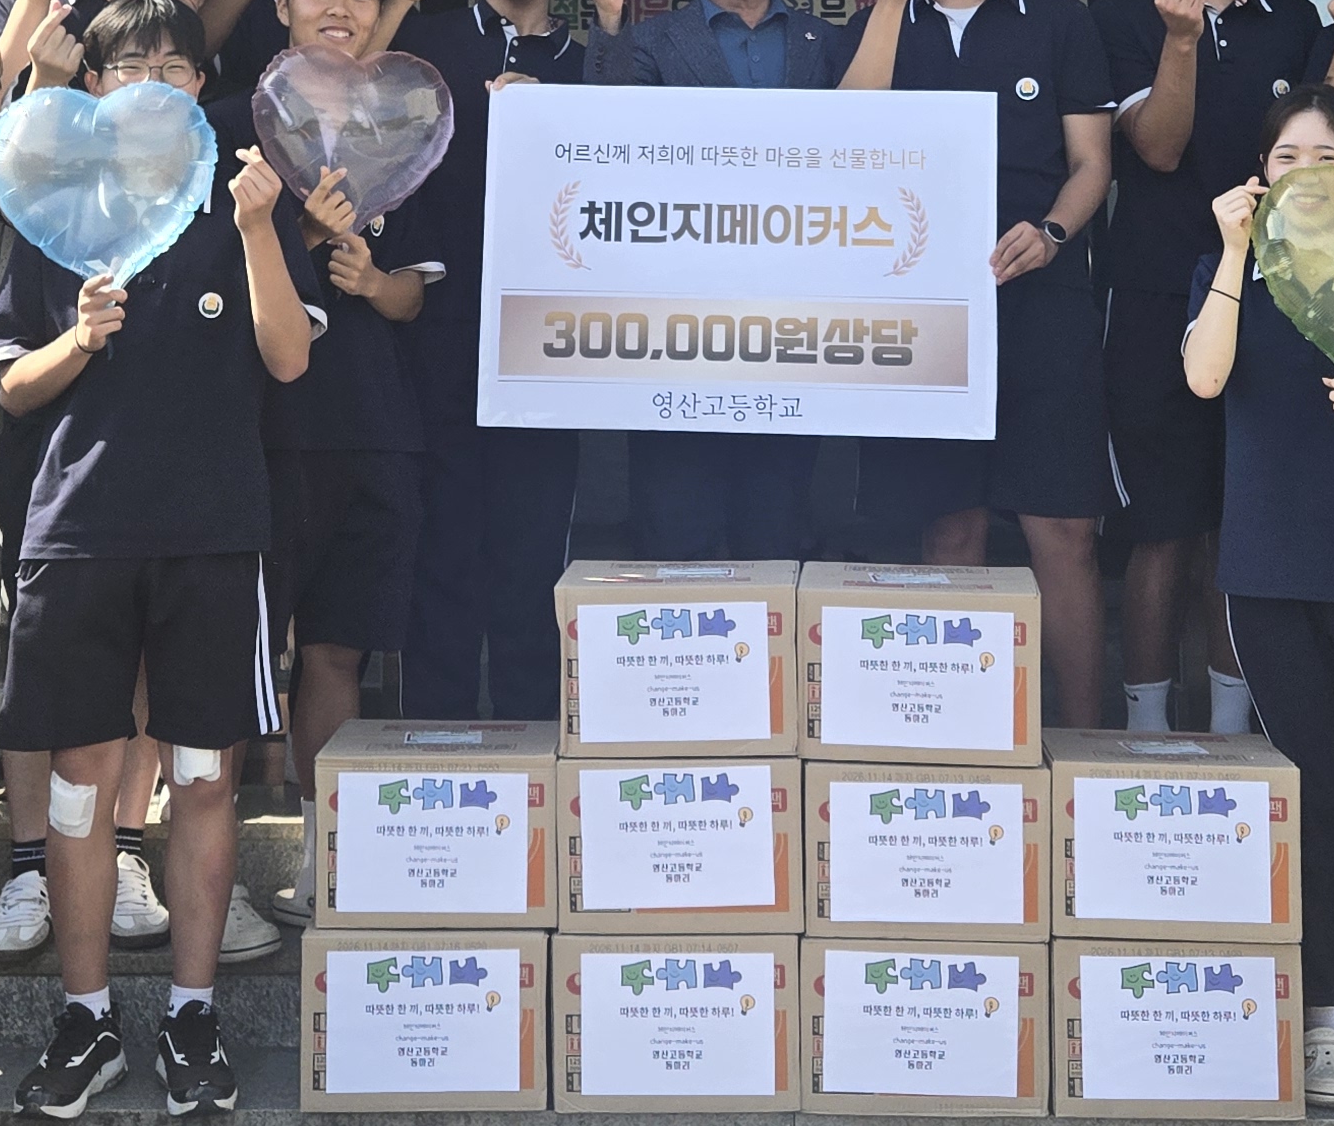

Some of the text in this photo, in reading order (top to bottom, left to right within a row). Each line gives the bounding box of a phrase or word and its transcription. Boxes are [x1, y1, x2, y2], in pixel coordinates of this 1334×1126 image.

[554, 142, 926, 171] 어르신께 저희에 따뜻한 마음을 선물합니다
[578, 200, 895, 248] 체인지메이커스
[651, 391, 804, 423] 영산고등학교
[617, 656, 645, 667] 따뜻한
[648, 656, 657, 666] 한
[675, 656, 703, 666] 따뜻한
[707, 655, 729, 665] 하루!
[860, 660, 888, 671] 따뜻한
[892, 661, 900, 671] 한
[919, 662, 948, 673] 따뜻한
[951, 663, 973, 674] 하루!
[650, 697, 699, 706] 영산고등학교
[892, 703, 941, 714] 영산고등학교
[377, 826, 405, 836] 따뜻한
[409, 826, 417, 836] 한
[435, 826, 463, 837] 따뜻한
[467, 826, 489, 837] 하루!
[619, 821, 647, 832] 따뜻한
[651, 821, 659, 832] 한
[678, 820, 707, 831] 따뜻한
[710, 820, 732, 830] 하루!
[869, 835, 897, 846] 따뜻한
[901, 836, 909, 846] 한
[928, 836, 957, 847] 따뜻한
[960, 837, 982, 847] 하루!
[1114, 832, 1143, 843] 따뜻한
[1146, 832, 1155, 843] 한
[1174, 833, 1203, 844] 따뜻한
[1206, 834, 1229, 845] 하루!
[408, 868, 457, 877] 영산고등학교
[653, 864, 702, 872] 영산고등학교
[901, 878, 950, 888] 영산고등학교
[1147, 876, 1197, 886] 영산고등학교
[366, 1004, 394, 1015] 따뜻한
[398, 1004, 406, 1015] 한
[425, 1003, 454, 1015] 따뜻한
[458, 1003, 479, 1014] 하루!
[620, 1007, 648, 1018] 따뜻한
[652, 1007, 661, 1018] 한
[679, 1007, 708, 1018] 따뜻한
[712, 1006, 734, 1018] 하루!
[863, 1005, 892, 1016] 따뜻한
[896, 1006, 904, 1017] 한
[923, 1007, 952, 1019] 따뜻한
[955, 1008, 978, 1019] 하루!
[1121, 1010, 1150, 1021] 따뜻한
[1153, 1010, 1162, 1021] 한
[1181, 1011, 1210, 1022] 따뜻한
[1213, 1012, 1236, 1022] 하루!
[398, 1047, 447, 1056] 영산고등학교
[653, 1050, 702, 1059] 영산고등학교
[895, 1050, 945, 1060] 영산고등학교
[1154, 1055, 1205, 1064] 영산고등학교
